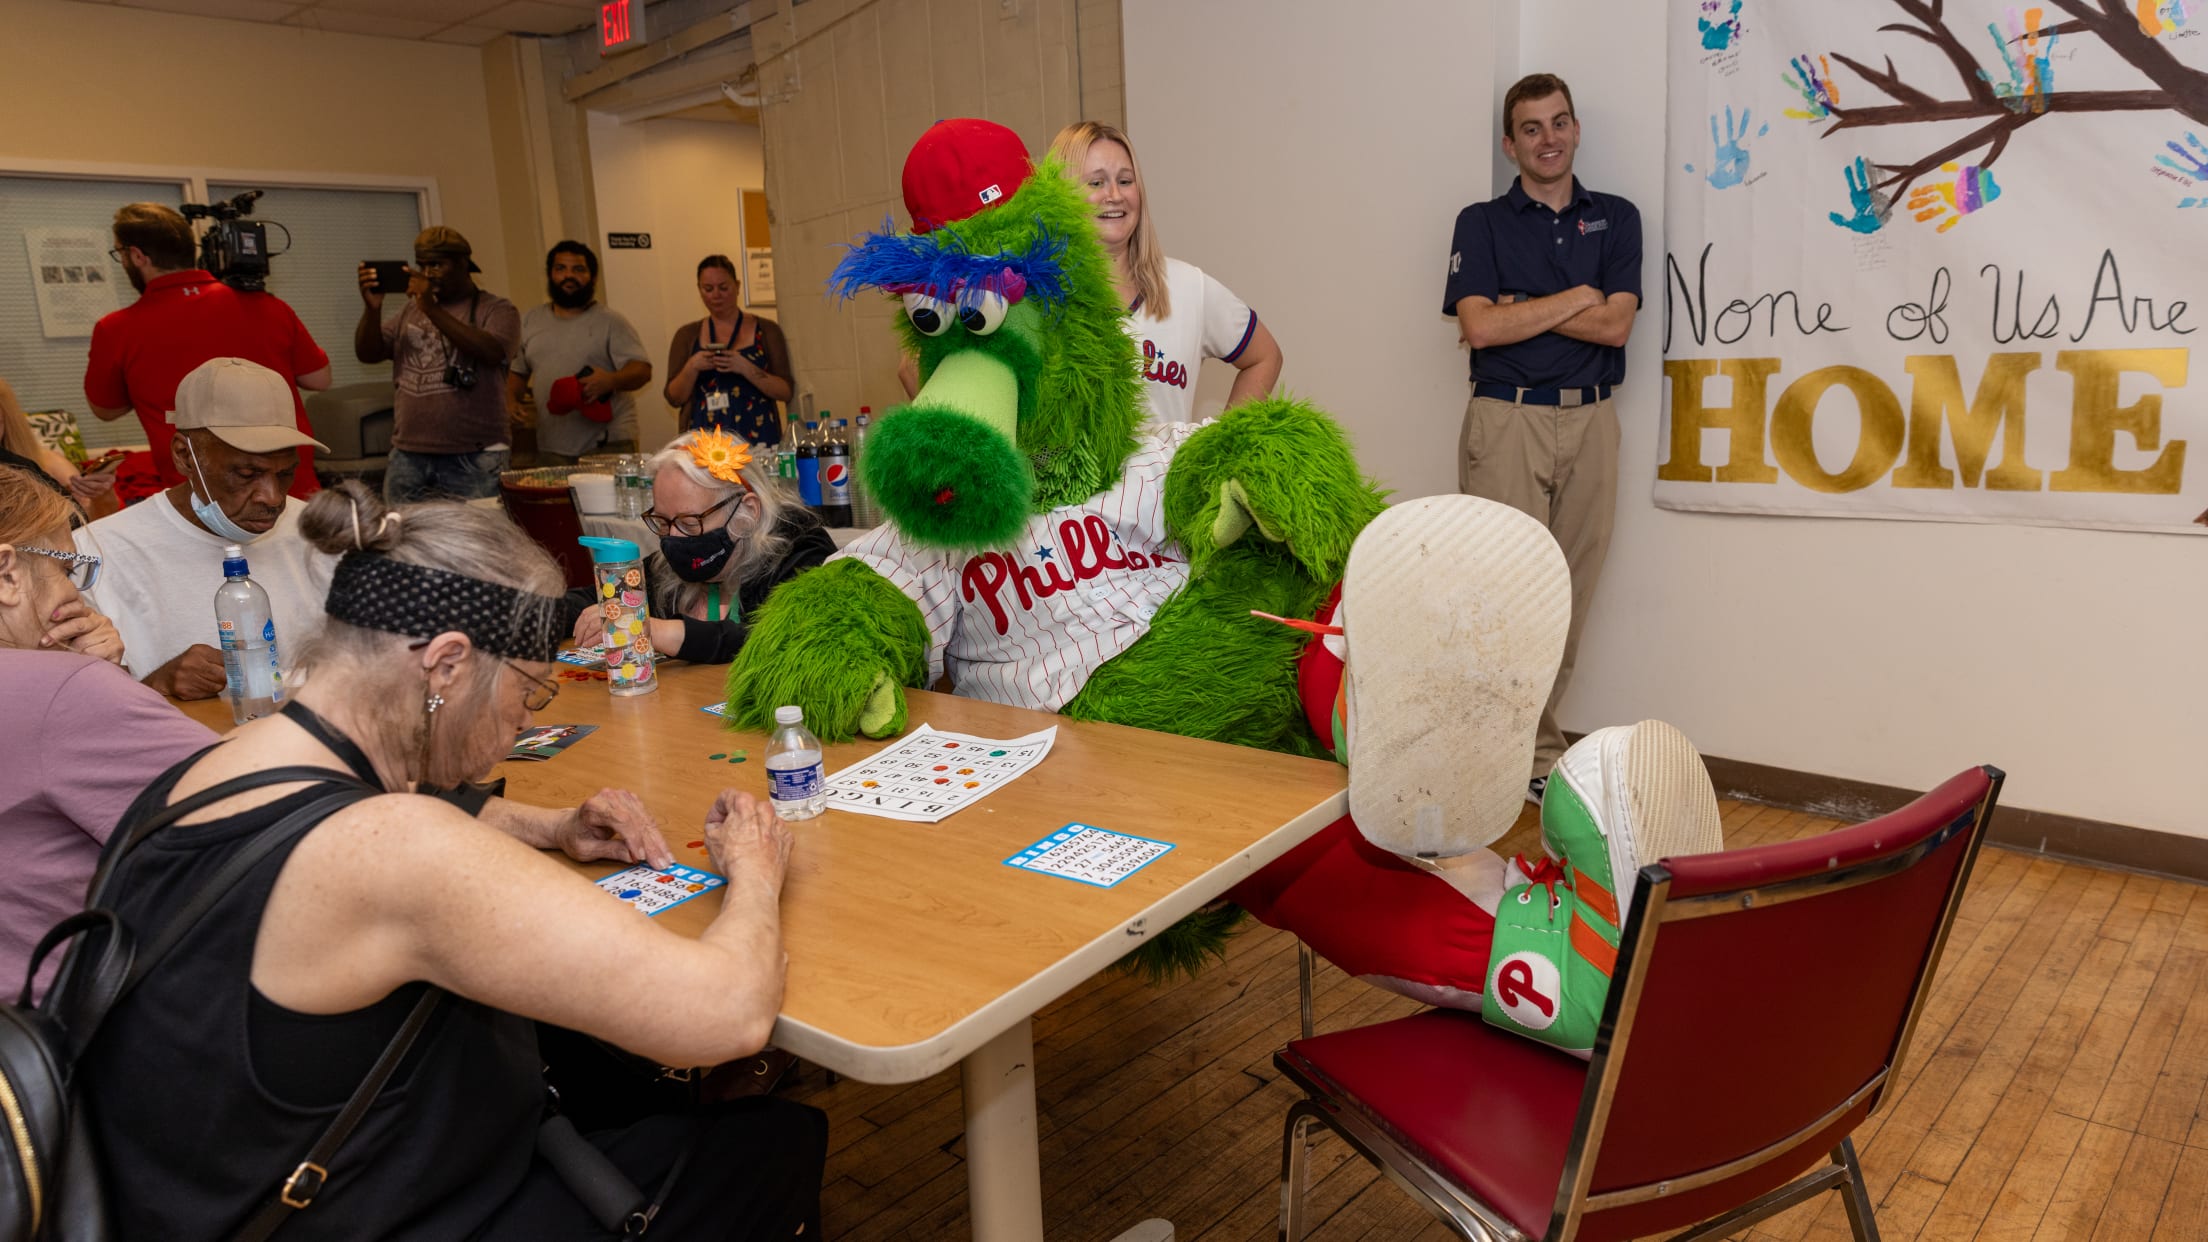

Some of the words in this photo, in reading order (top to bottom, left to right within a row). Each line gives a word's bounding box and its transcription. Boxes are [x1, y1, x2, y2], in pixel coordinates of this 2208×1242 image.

[602, 0, 630, 47] EXIT
[1663, 243, 1850, 354] None
[1886, 267, 1951, 344] of
[1980, 264, 2060, 344] Us
[2069, 248, 2198, 342] Are
[1658, 347, 2190, 495] HOME
[1498, 959, 1554, 1018] P
